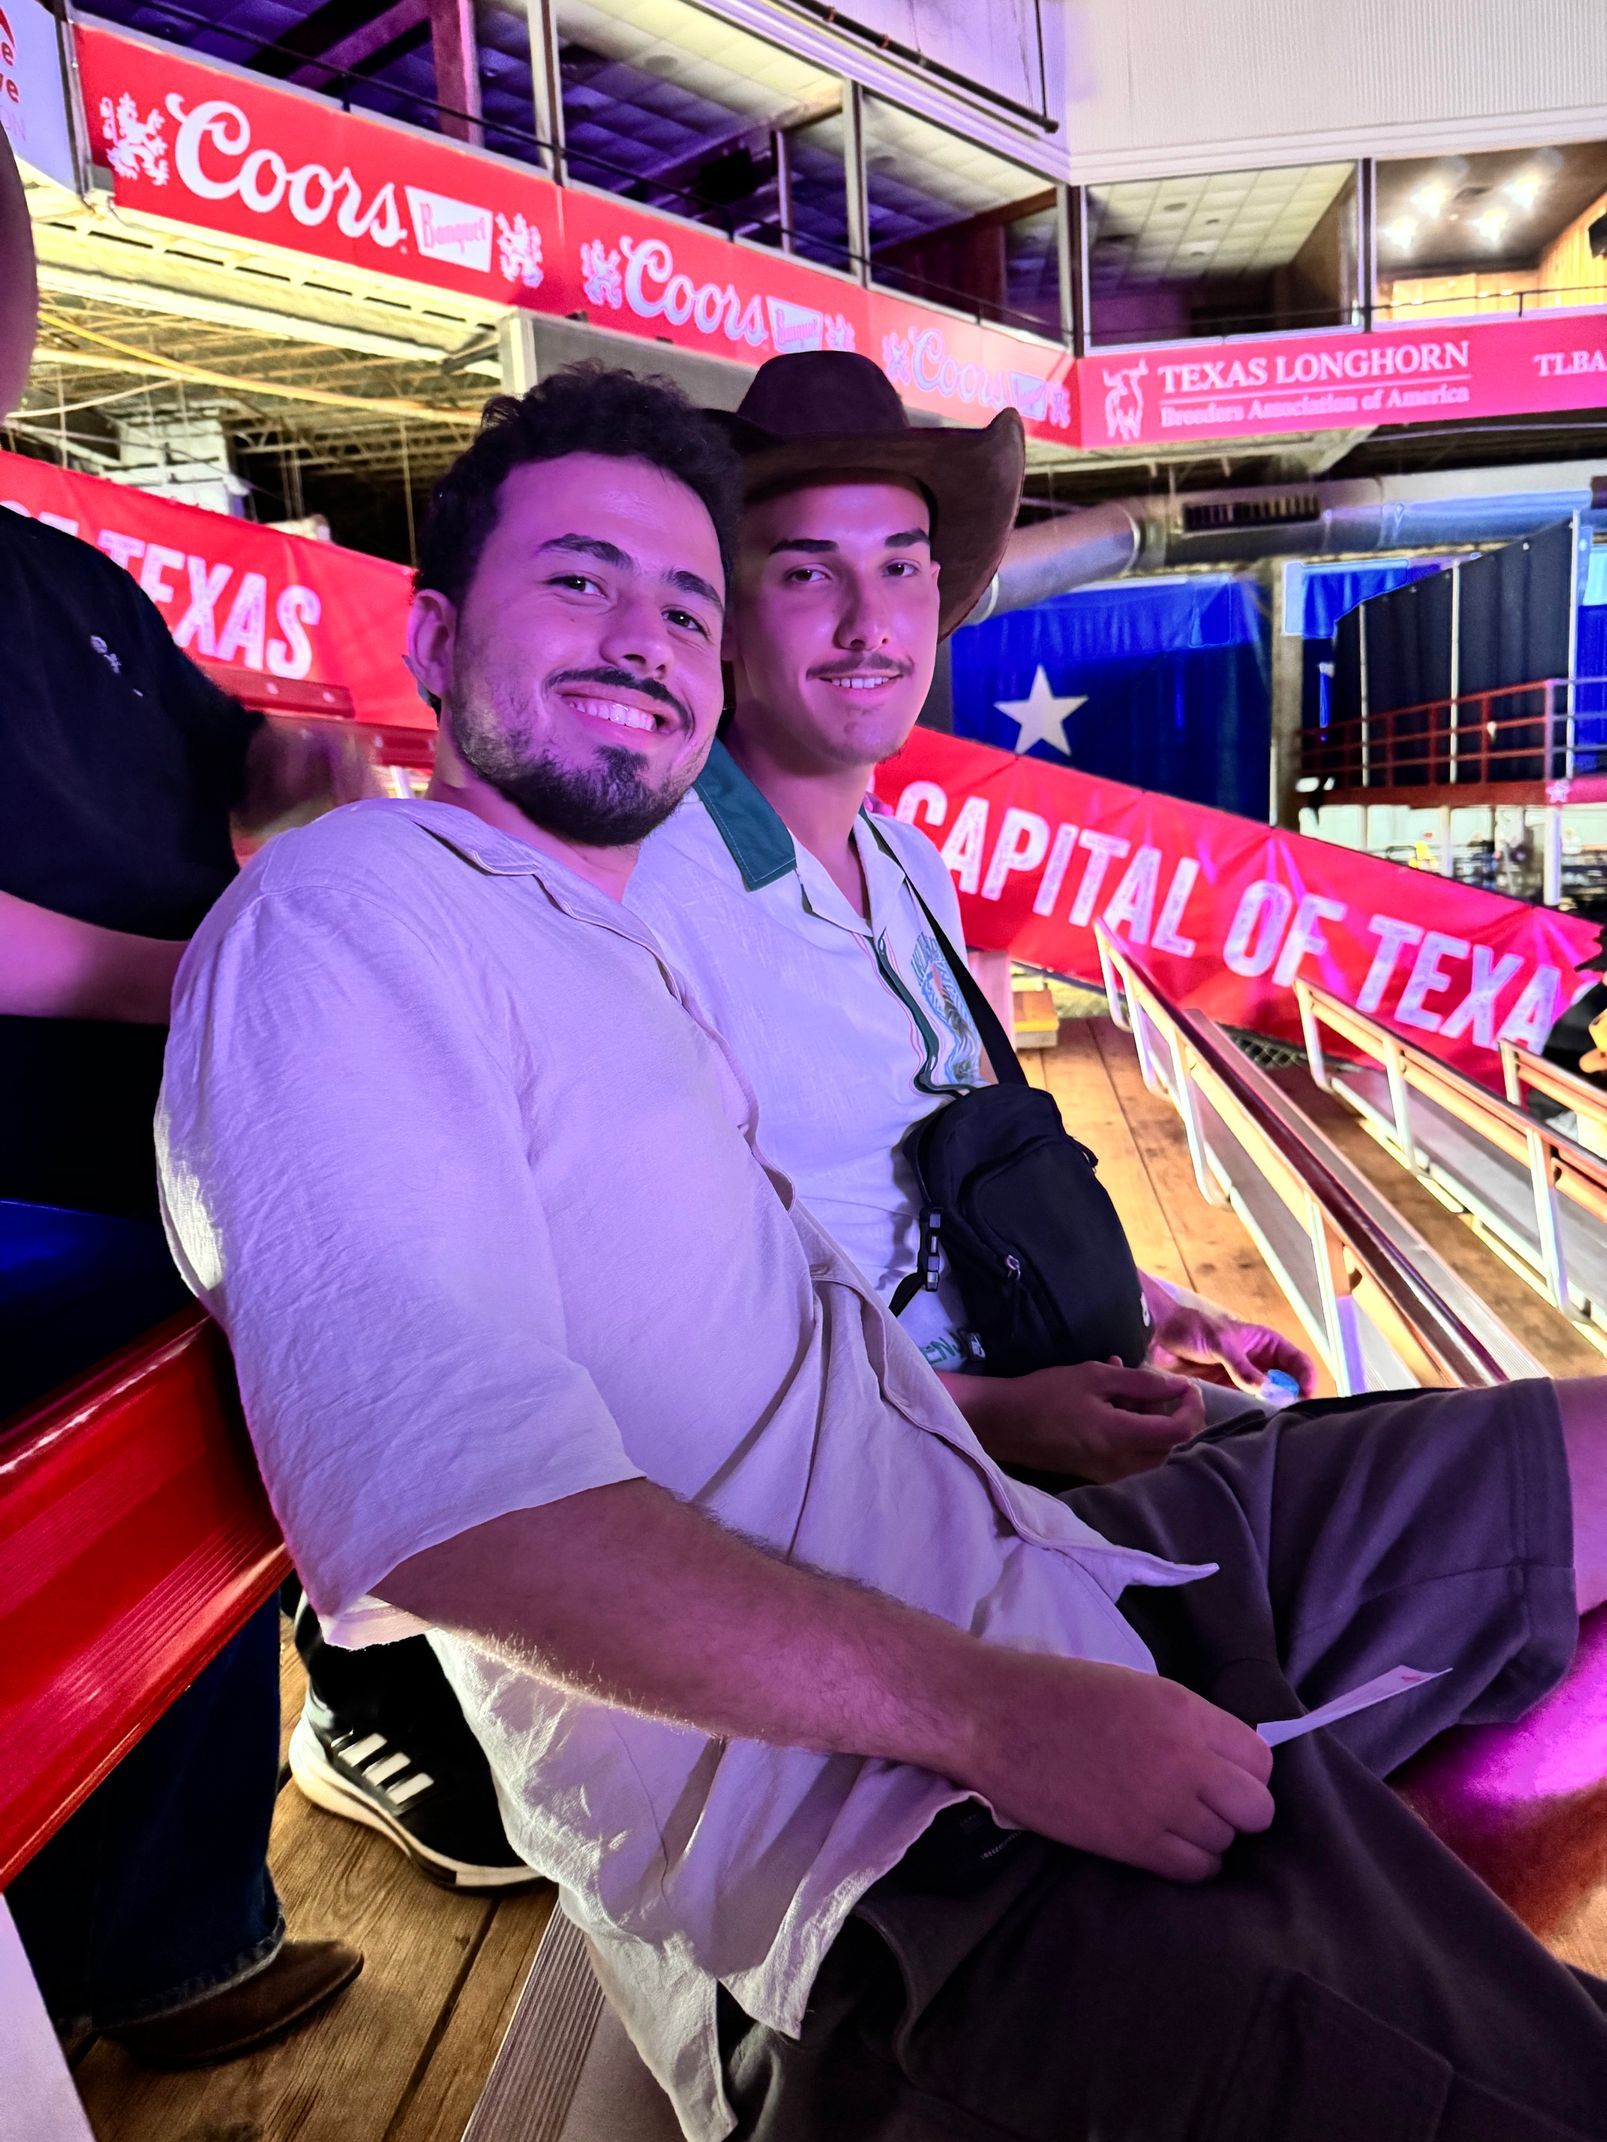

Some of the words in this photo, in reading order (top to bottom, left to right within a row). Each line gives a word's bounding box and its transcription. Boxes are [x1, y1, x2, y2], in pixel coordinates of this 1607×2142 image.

[166, 93, 407, 248] Coors
[620, 235, 769, 346] Coors
[908, 326, 1010, 411] Coors
[1157, 356, 1269, 393] TEXAS
[1276, 340, 1470, 384] LONGHORN
[1160, 403, 1245, 428] Breeders
[1248, 394, 1358, 420] Association
[1362, 389, 1385, 410] of
[1386, 383, 1470, 409] America
[1221, 878, 1347, 988] OF
[1354, 913, 1598, 1057] TEXA
